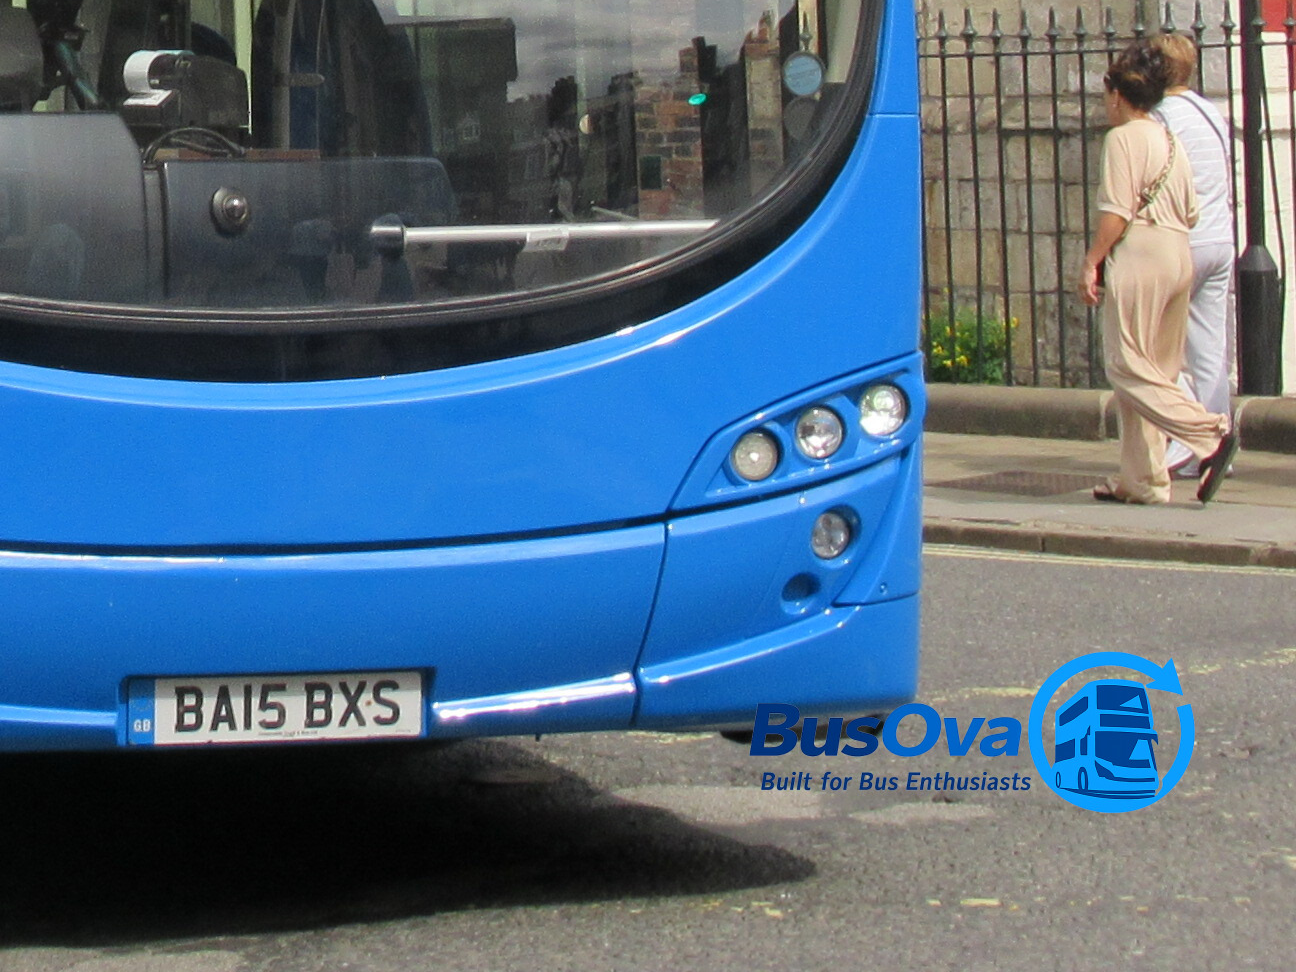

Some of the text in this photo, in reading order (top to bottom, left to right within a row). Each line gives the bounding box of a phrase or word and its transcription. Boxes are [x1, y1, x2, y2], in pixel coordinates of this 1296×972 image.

[174, 679, 401, 734] BA15 BXS
[133, 718, 151, 732] GB
